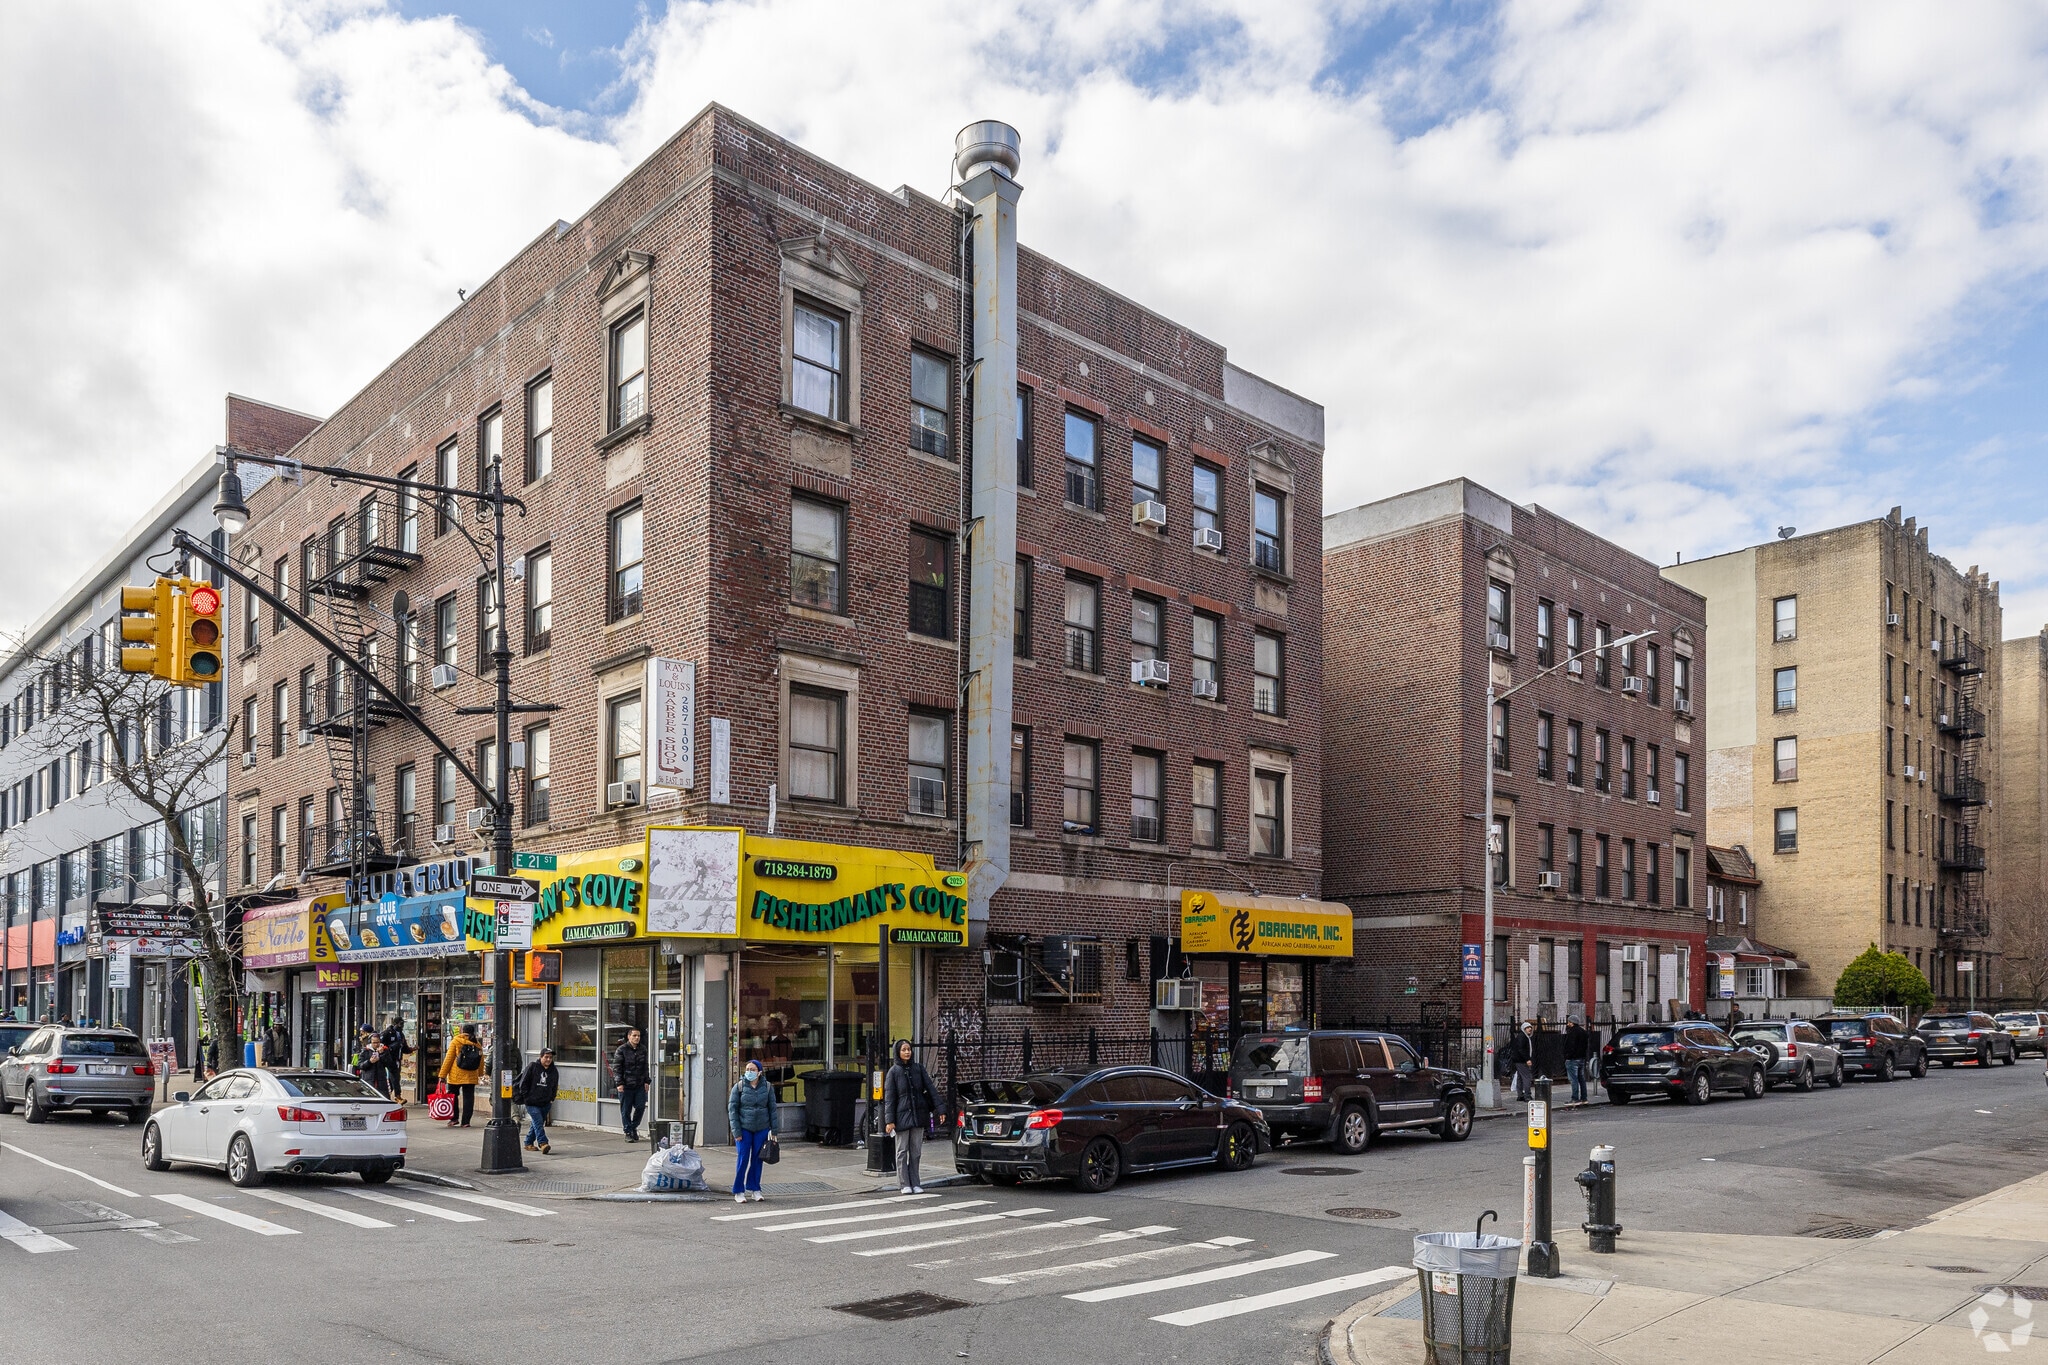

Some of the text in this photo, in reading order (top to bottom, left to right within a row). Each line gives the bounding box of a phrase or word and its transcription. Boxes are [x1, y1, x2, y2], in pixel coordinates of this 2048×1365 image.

[665, 662, 685, 672] RAY
[659, 679, 691, 691] LOUIS'S
[664, 691, 677, 764] BARBER SHOP
[681, 696, 689, 762] 287-1090
[516, 854, 553, 868] E 21 ST
[764, 862, 833, 880] 718-284-1879
[345, 873, 387, 904] DELI
[395, 871, 406, 896] &
[949, 876, 963, 885] 2025
[481, 882, 530, 896] ONE WAY
[580, 873, 639, 914] COVE
[380, 901, 396, 914] BLUE
[753, 883, 967, 932] FISHERMAN'S COVE
[376, 915, 388, 927] SKY
[259, 920, 306, 948] Nails
[312, 902, 328, 958] NAILS
[499, 926, 507, 935] 15
[565, 922, 627, 941] JAMAICAN GRILL
[897, 930, 961, 943] JAMAICAN GRILL
[1324, 925, 1343, 941] INC.
[319, 968, 360, 983] Nails
[560, 981, 597, 997] Jerk Chicken
[669, 1021, 675, 1032] A
[656, 1173, 691, 1190] BID
